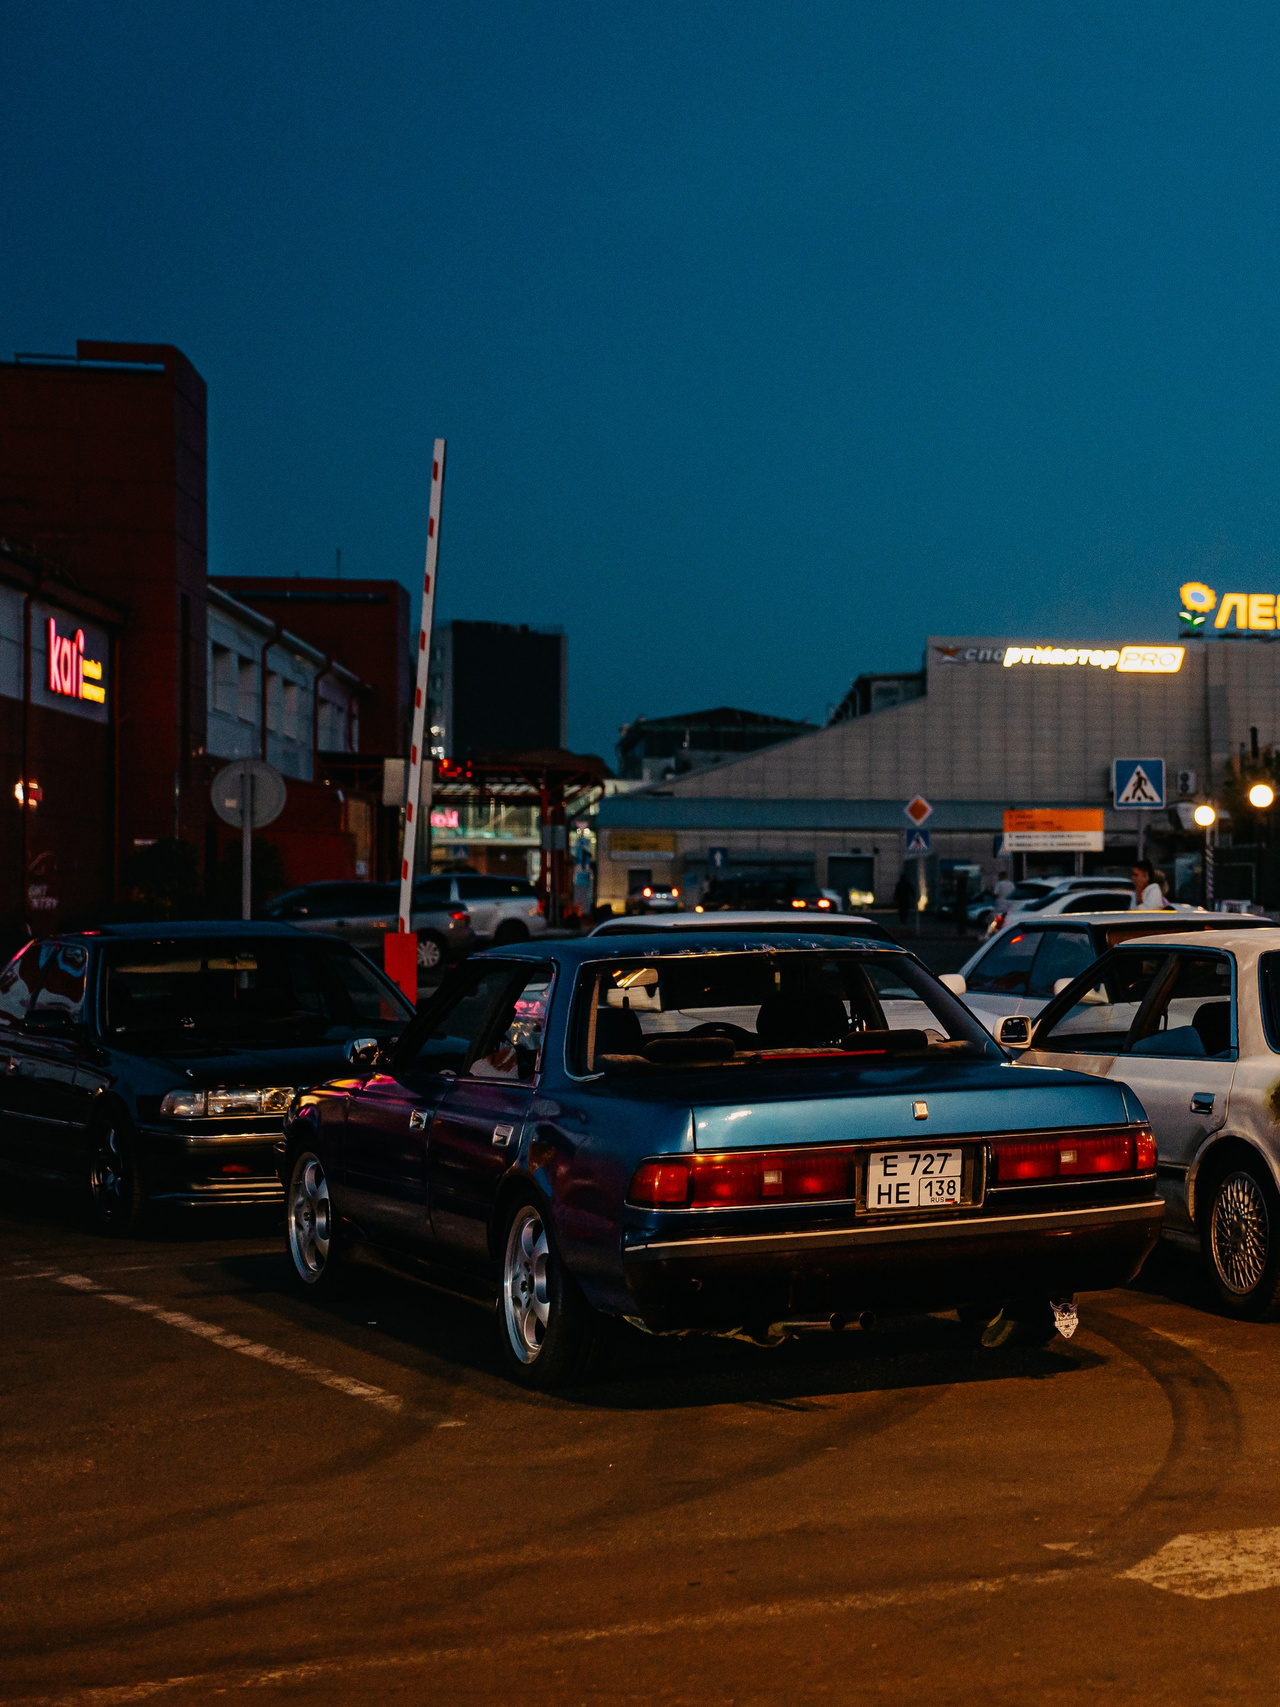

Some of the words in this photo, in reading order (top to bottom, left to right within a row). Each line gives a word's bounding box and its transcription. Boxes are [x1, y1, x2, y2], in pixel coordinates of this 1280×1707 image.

[49, 617, 85, 700] kari
[1121, 650, 1178, 668] PRO
[883, 1155, 898, 1176] Е
[908, 1152, 949, 1175] 727
[877, 1182, 910, 1205] НЕ
[924, 1179, 956, 1197] 138
